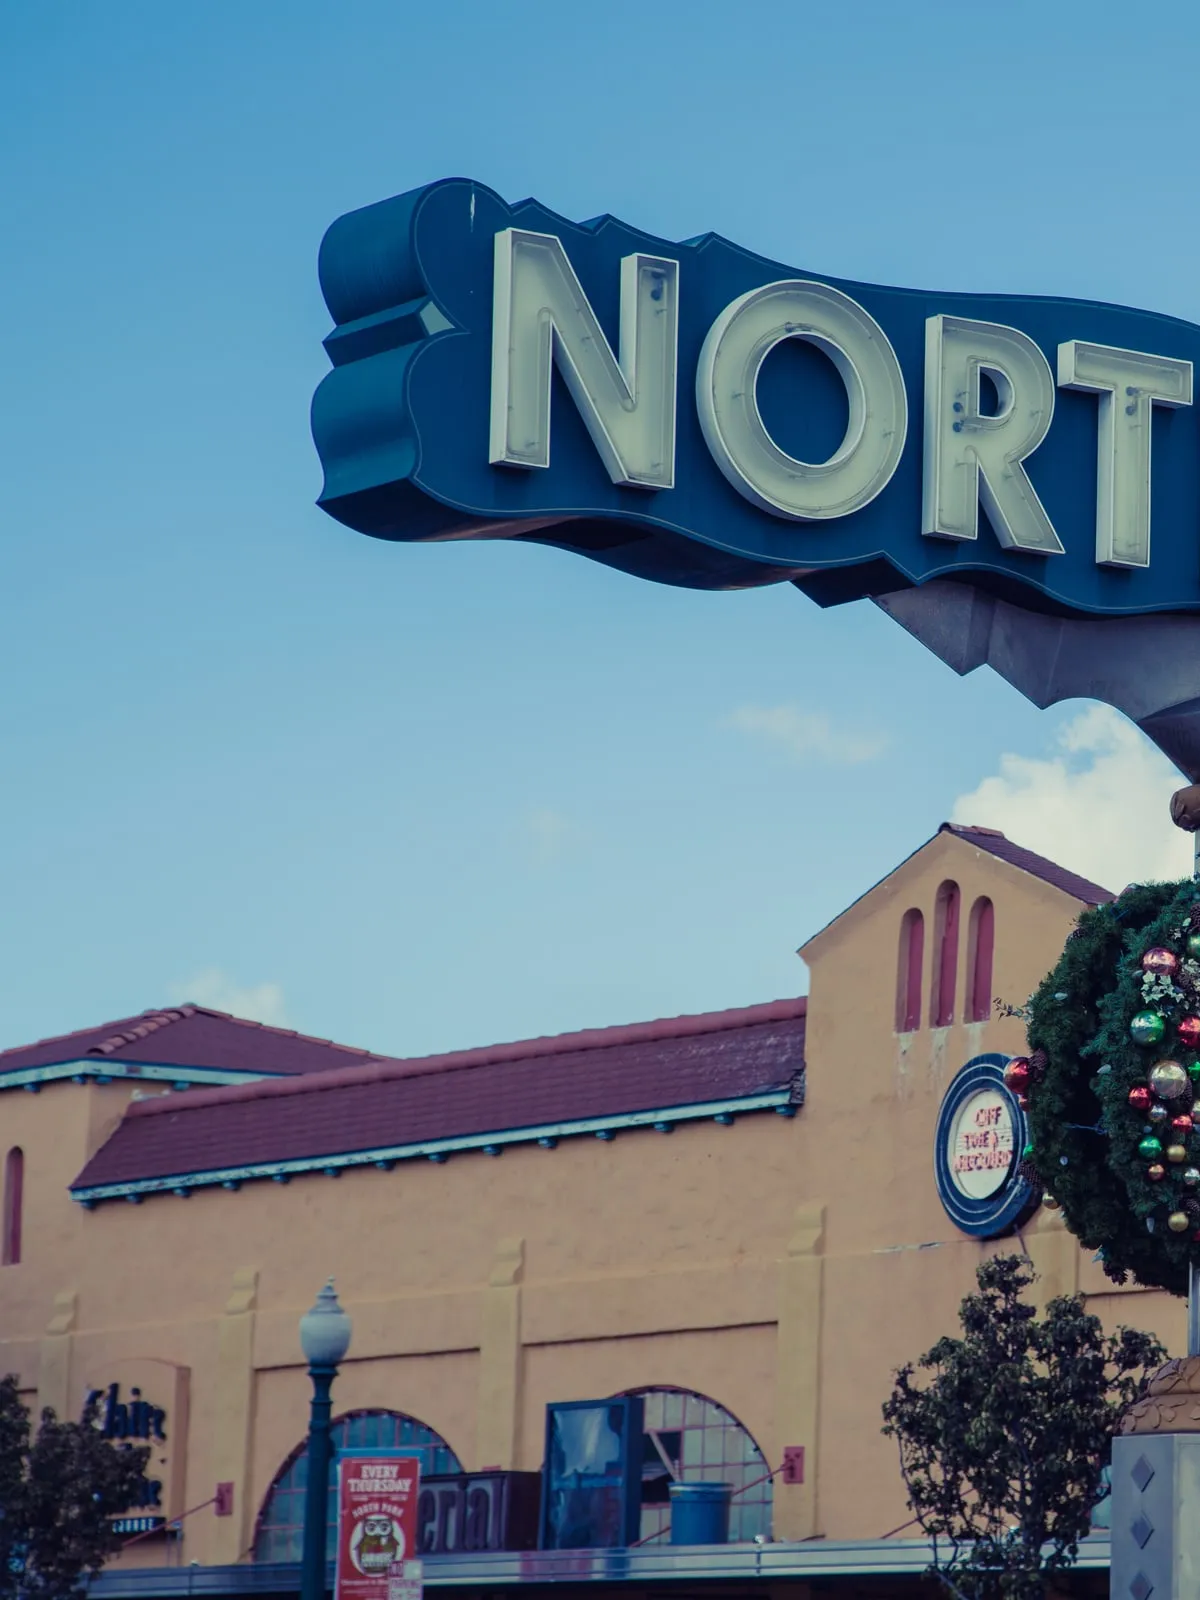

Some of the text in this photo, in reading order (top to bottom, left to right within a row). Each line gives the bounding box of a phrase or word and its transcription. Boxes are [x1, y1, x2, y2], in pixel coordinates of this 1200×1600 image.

[361, 1464, 399, 1479] EVERY
[347, 1478, 412, 1493] THURSDAY
[417, 1480, 504, 1551] erial
